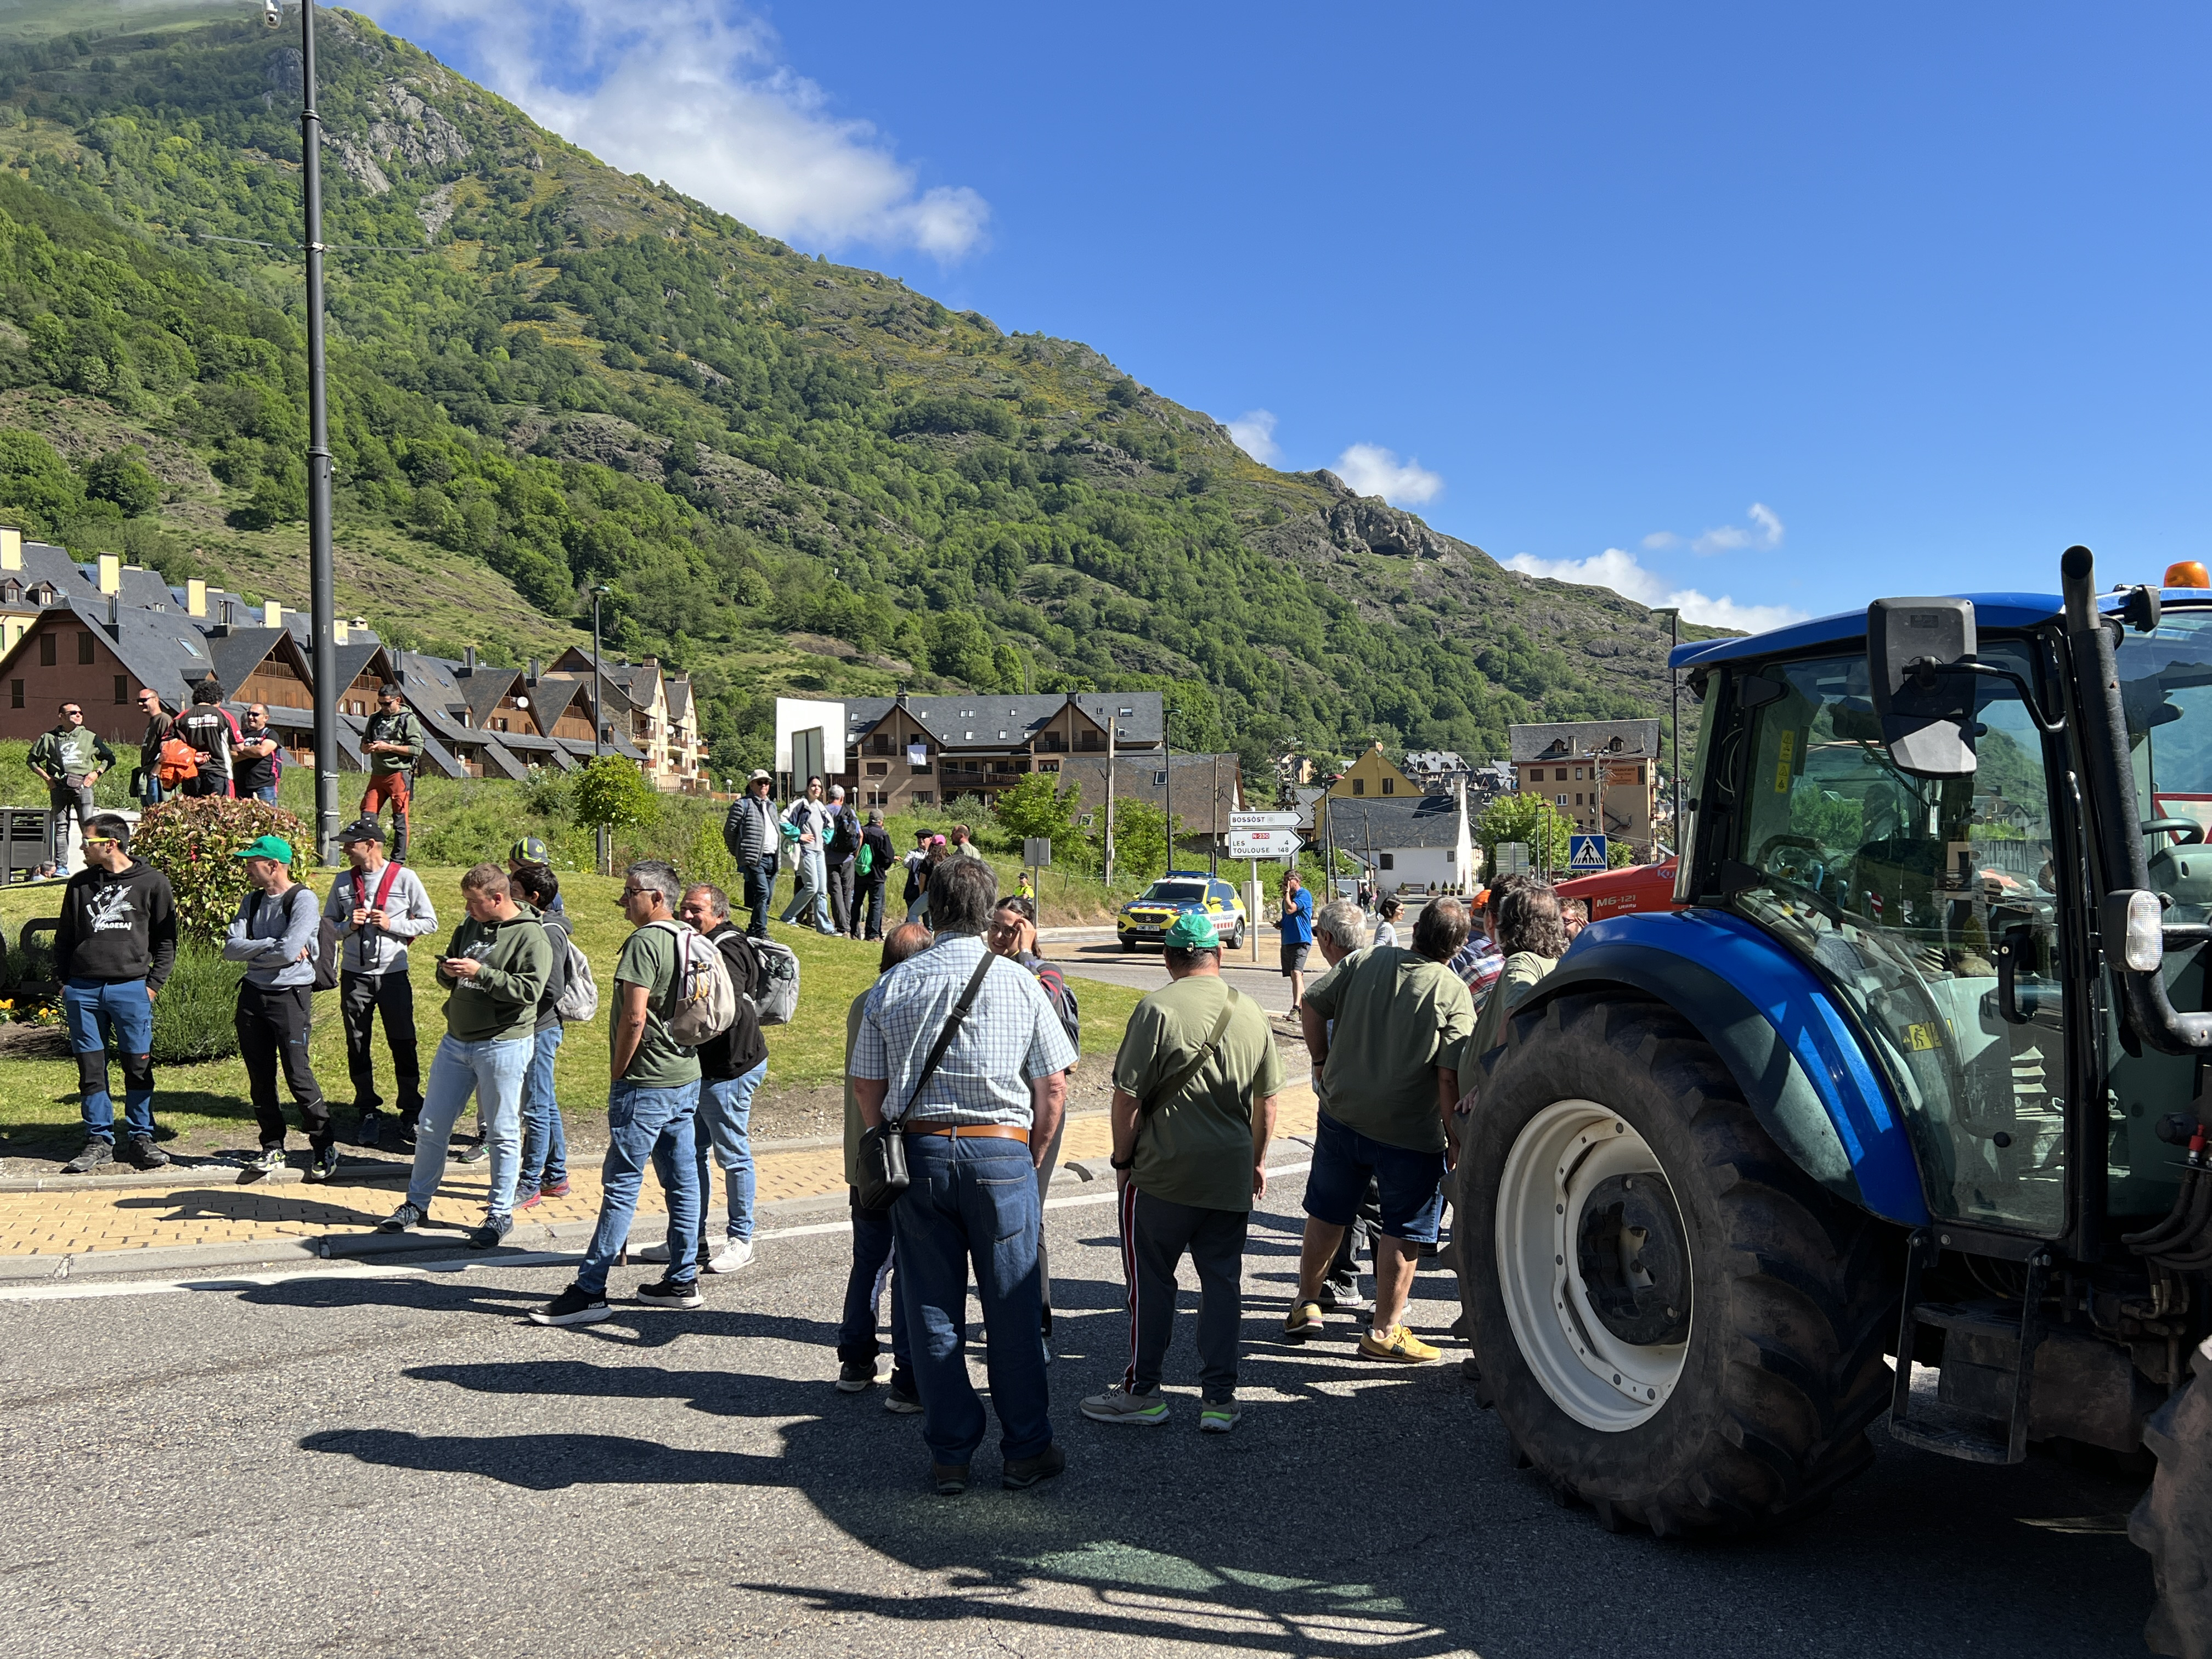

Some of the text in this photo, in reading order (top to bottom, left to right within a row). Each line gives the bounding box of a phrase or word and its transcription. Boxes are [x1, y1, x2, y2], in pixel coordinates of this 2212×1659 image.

[188, 714, 218, 725] aprilia
[1596, 895, 1636, 907] M6-121
[588, 1301, 605, 1310] HOKA
